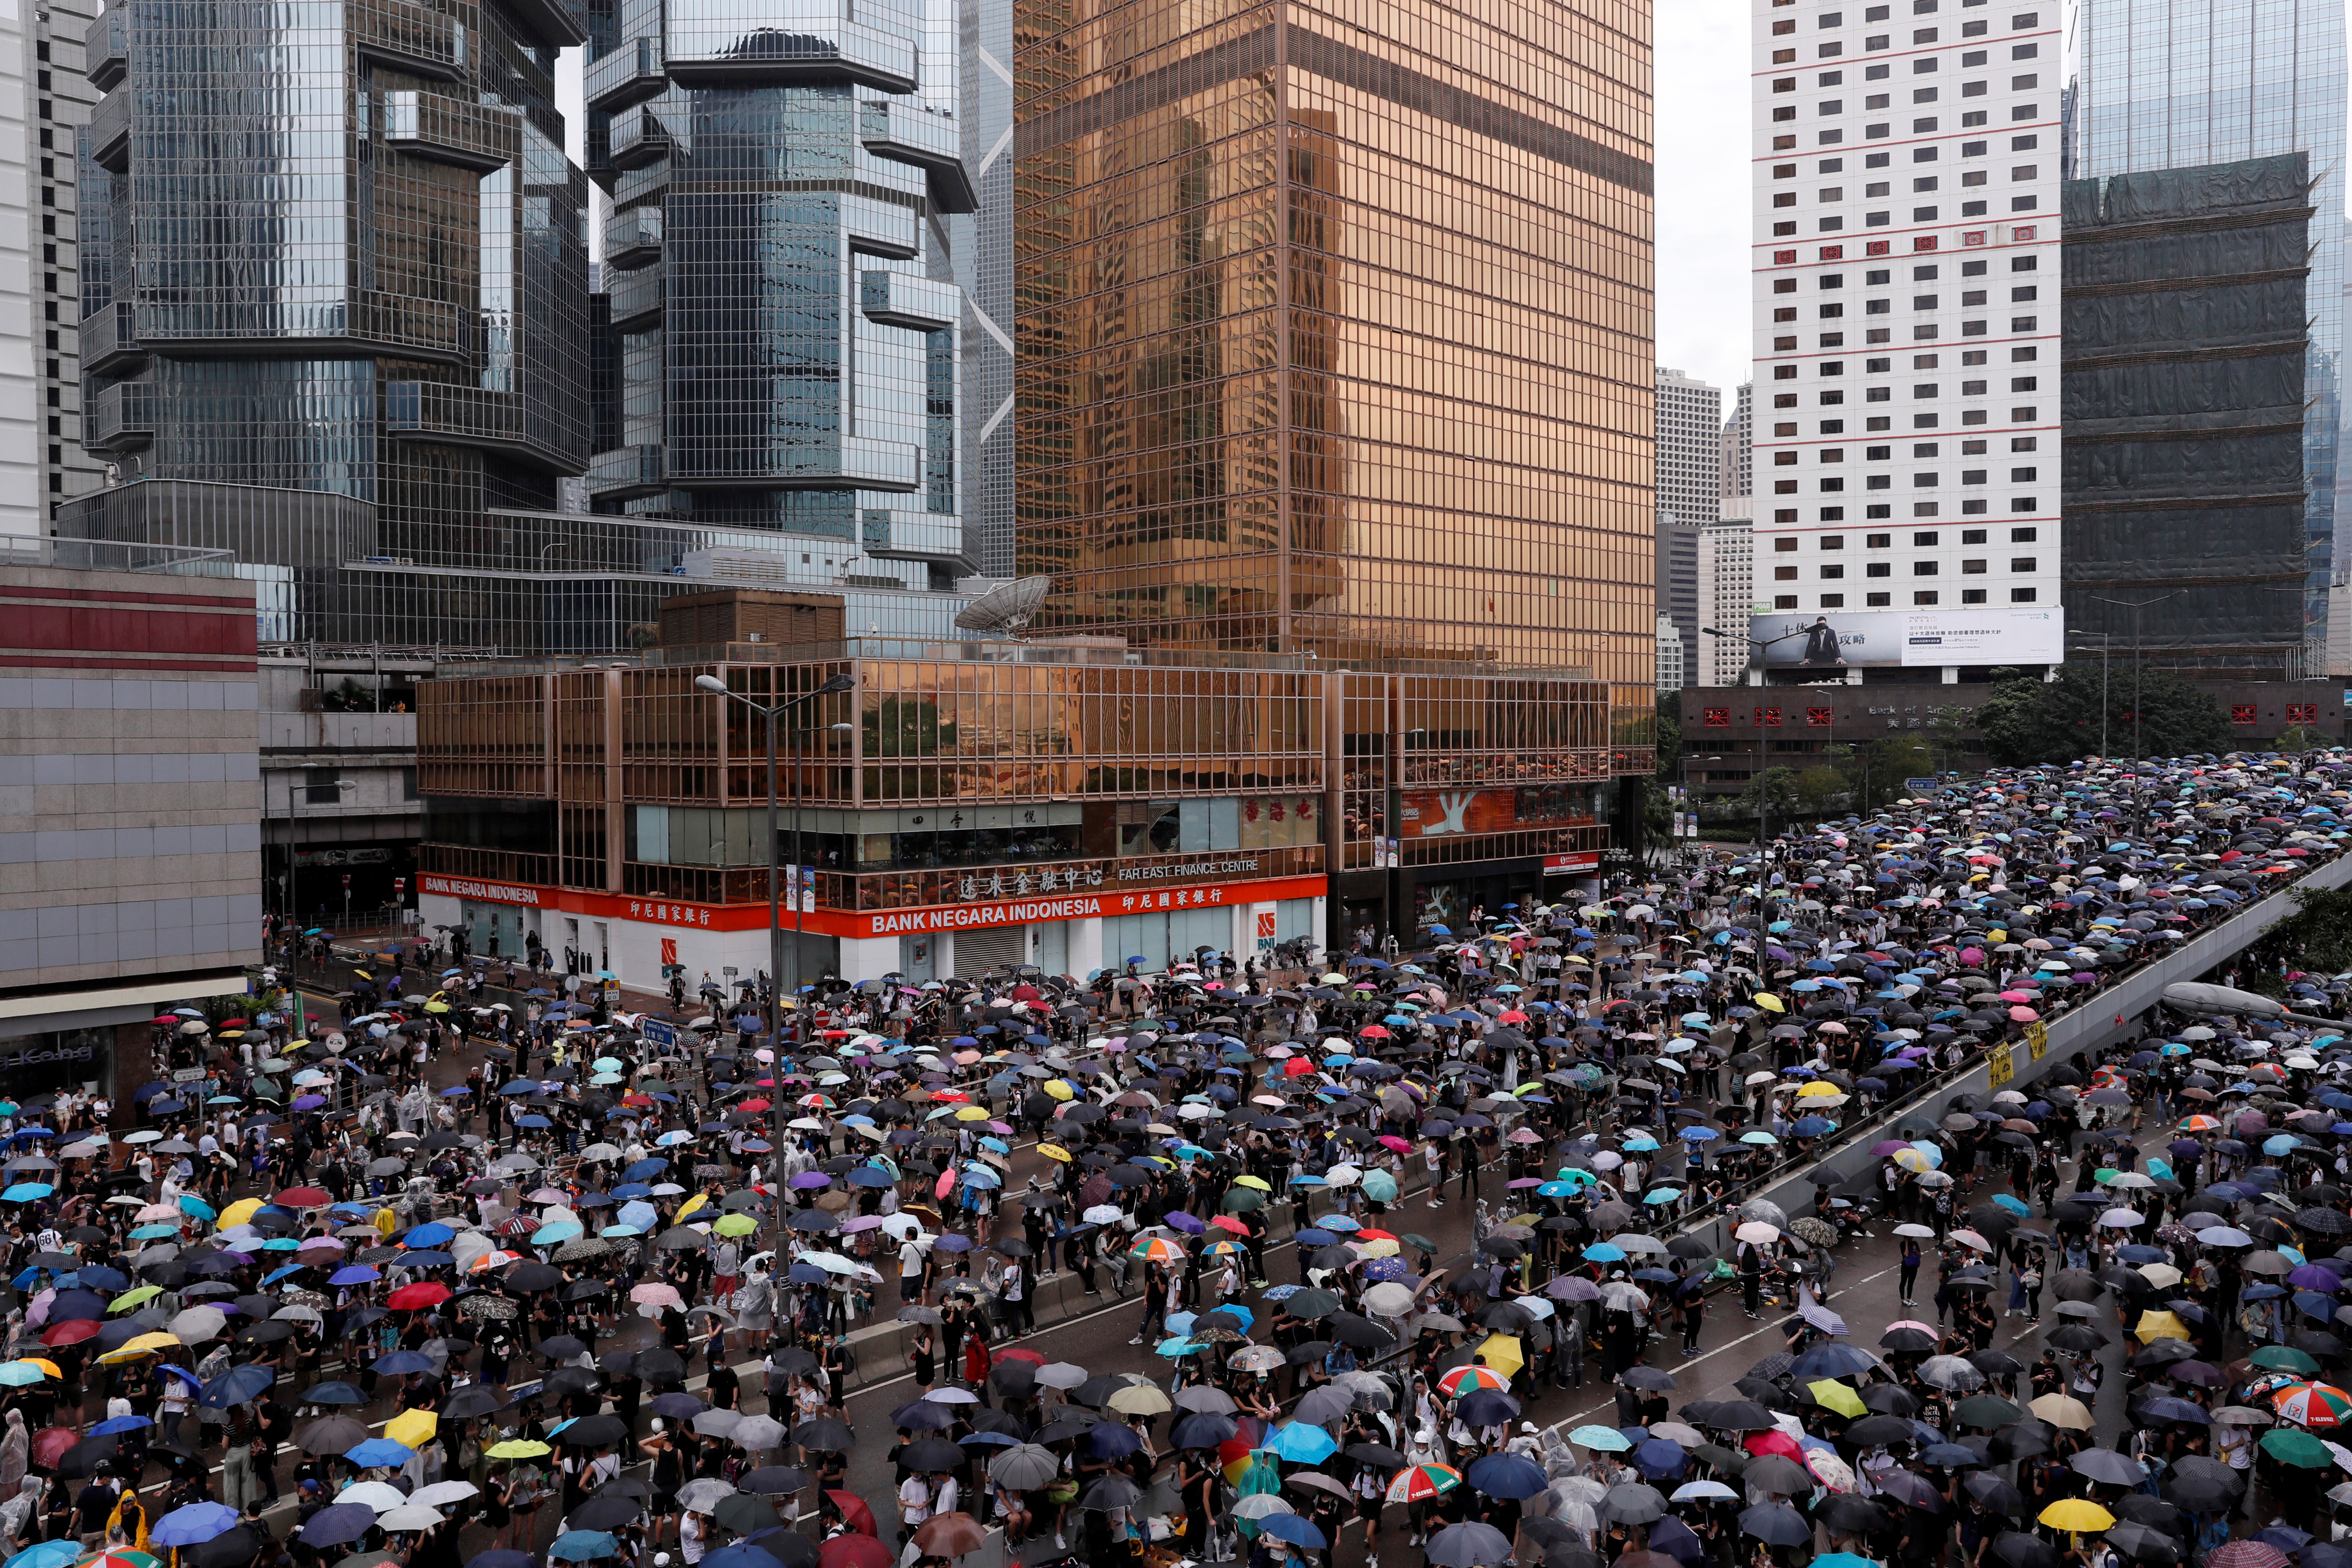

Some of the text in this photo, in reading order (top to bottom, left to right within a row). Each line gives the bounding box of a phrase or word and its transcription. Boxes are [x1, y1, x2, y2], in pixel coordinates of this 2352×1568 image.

[1838, 633, 1865, 646] 攻略
[1869, 705, 1896, 715] Bank
[1905, 705, 1917, 714] of
[1119, 859, 1258, 881] FAR EAST FINANCE CENTRE
[426, 877, 538, 904] BANK NEGARA INDONESIA
[959, 867, 1103, 900] 遠東金融中心
[1122, 888, 1223, 911] 印尼國家銀行
[631, 901, 710, 926] 印尼國家銀行
[872, 898, 1101, 933] BANK NEGARA INDONESIA
[1418, 913, 1439, 923] 大快活
[1257, 937, 1275, 950] BNI
[19, 1046, 93, 1066] Kong
[39, 1234, 52, 1245] 66
[1438, 1479, 1456, 1490] 7-ELEVEN
[1411, 1488, 1434, 1498] 7-ELEVEN
